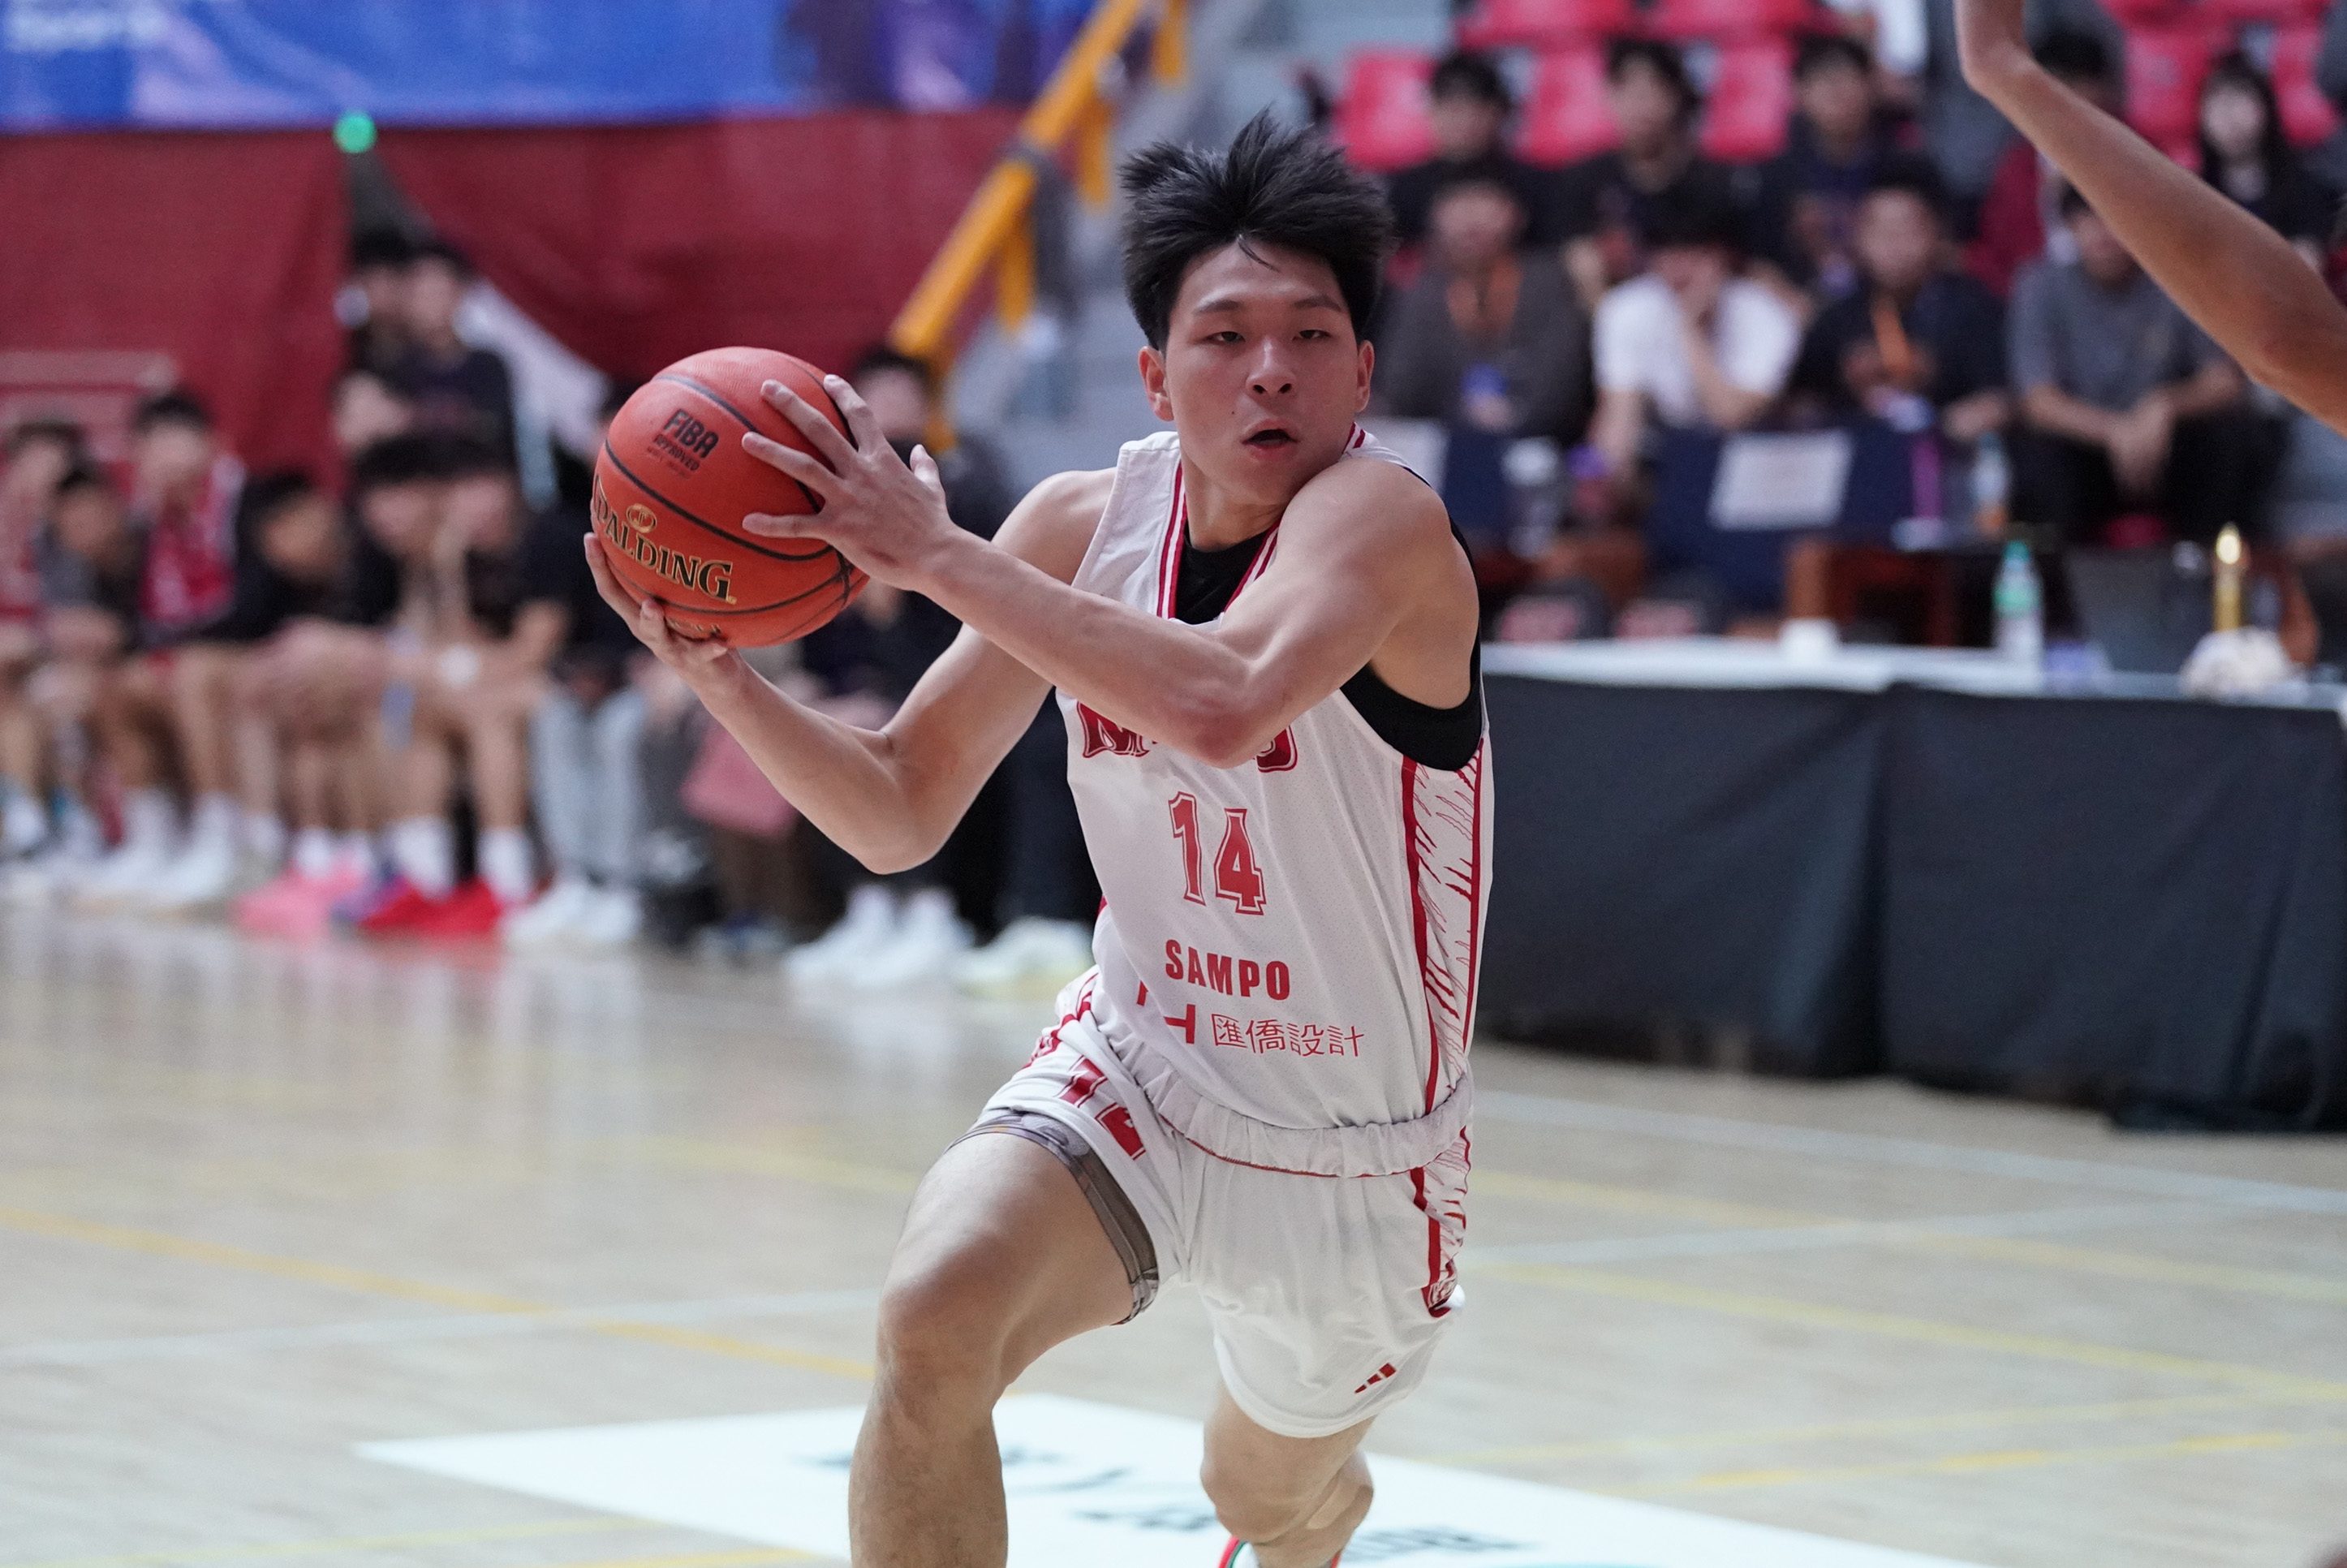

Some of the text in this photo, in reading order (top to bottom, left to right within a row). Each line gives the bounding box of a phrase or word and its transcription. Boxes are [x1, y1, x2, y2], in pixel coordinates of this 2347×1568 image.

[663, 408, 719, 459] FIBA
[1168, 791, 1268, 916] 14
[1165, 939, 1290, 1001] SAMPO
[1211, 1013, 1364, 1058] 匯僑設計
